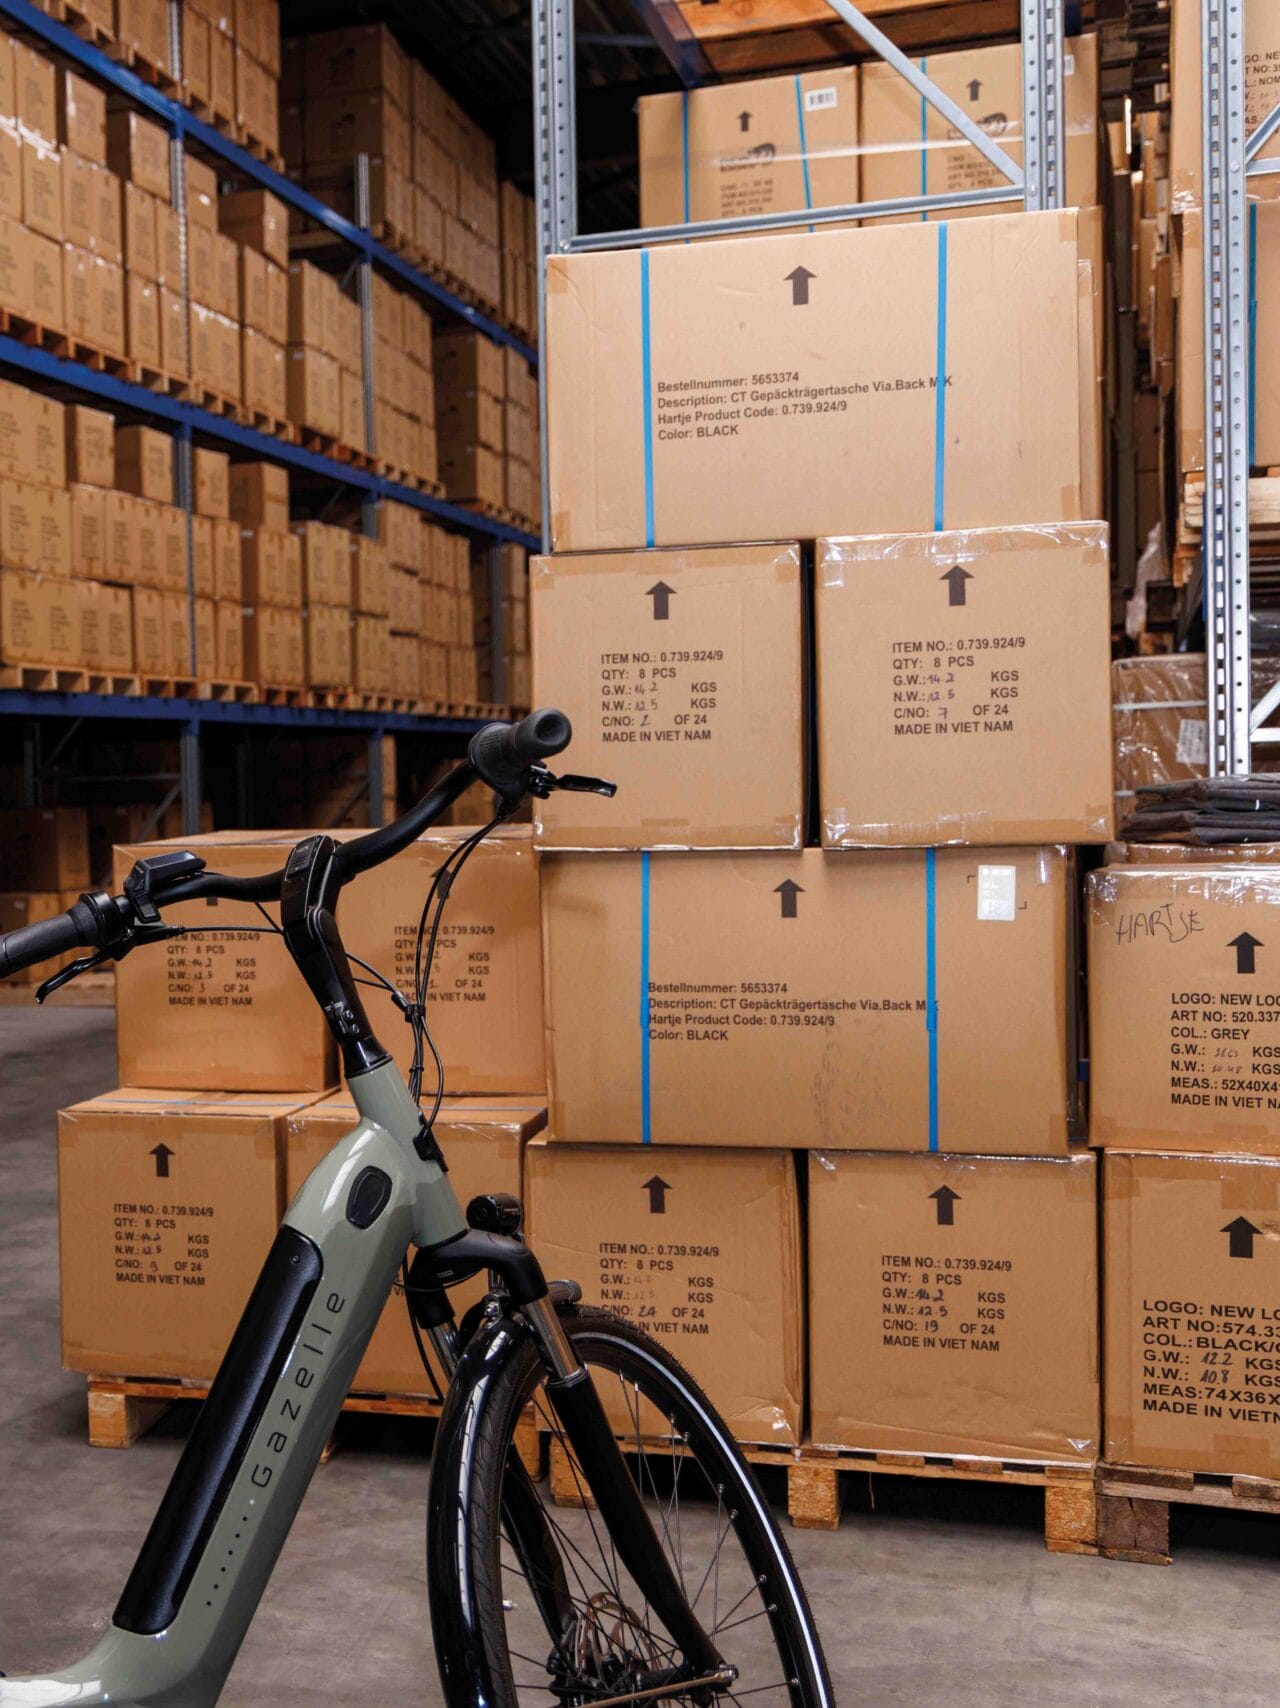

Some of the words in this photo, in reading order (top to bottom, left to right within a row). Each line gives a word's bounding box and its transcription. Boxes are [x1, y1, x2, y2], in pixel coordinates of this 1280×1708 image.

[658, 377, 747, 393] Bestellnummer:
[752, 372, 799, 386] 5653374
[658, 394, 726, 409] Description:
[731, 392, 747, 403] CT
[751, 383, 869, 403] Gepäckträgertasche
[873, 378, 925, 392] Via.Back
[658, 411, 692, 425] Hartje
[696, 407, 741, 422] Product
[744, 405, 778, 418] Code:
[782, 400, 847, 415] 0.739.924/9
[658, 428, 693, 440] Color:
[697, 425, 739, 438] BLACK
[893, 642, 922, 653] ITEM
[927, 640, 952, 651] NO.:
[956, 637, 1026, 650] 0.739.924/9
[601, 654, 629, 664] ITEM
[632, 653, 657, 663] NO.:
[660, 650, 723, 662] 0.739.924/9
[893, 658, 922, 670] QTY:
[934, 658, 940, 667] 8
[948, 656, 974, 666] PCS
[601, 669, 629, 680] QTY:
[639, 669, 645, 678] 8
[652, 668, 676, 678] PCS
[894, 675, 925, 686] G.W.:
[991, 671, 1019, 682] KGS
[601, 685, 631, 695] G.W.:
[691, 682, 717, 693] KGS
[894, 691, 925, 702] N.W.:
[991, 687, 1018, 698] KGS
[602, 701, 631, 711] N.W.:
[691, 698, 716, 708] KGS
[894, 708, 929, 718] C/NO:
[973, 705, 990, 715] OF
[994, 704, 1008, 715] 24
[602, 716, 634, 727] C/NO:
[674, 715, 690, 725] OF
[694, 714, 707, 724] 24
[894, 724, 931, 735] MADE
[936, 723, 947, 734] IN
[952, 722, 980, 733] VIET
[984, 721, 1013, 732] NAM
[602, 731, 636, 742] MADE
[640, 731, 651, 741] IN
[655, 730, 680, 741] VIET
[684, 730, 711, 740] NAM
[649, 982, 736, 994] Bestellnummer:
[741, 983, 787, 994] 5653374
[649, 998, 716, 1011] Description:
[720, 999, 736, 1010] CT
[740, 999, 857, 1013] Gepäckträgertasche
[860, 999, 912, 1011] Via.Back
[1172, 993, 1215, 1005] LOGO:
[1220, 994, 1252, 1006] NEW
[649, 1014, 682, 1027] Hartje
[685, 1014, 730, 1025] Product
[734, 1015, 767, 1026] Code:
[771, 1015, 835, 1027] 0.739.924/9
[1171, 1011, 1198, 1021] ART
[1203, 1011, 1227, 1022] NO:
[649, 1029, 683, 1041] Color:
[687, 1030, 728, 1041] BLACK
[1171, 1027, 1207, 1039] COL.:
[1211, 1028, 1250, 1040] GREY
[1171, 1044, 1205, 1055] G.W.:
[1171, 1060, 1205, 1072] N.W.:
[1171, 1077, 1217, 1089] MEAS.:
[1171, 1094, 1210, 1106] MADE
[1215, 1096, 1228, 1106] IN
[1232, 1097, 1262, 1109] VIET
[114, 1203, 136, 1213] ITEM
[162, 1206, 214, 1216] 0.739.924/9
[115, 1218, 137, 1227] QTY:
[156, 1219, 176, 1229] PCS
[882, 1256, 911, 1266] ITEM
[915, 1257, 940, 1268] NO.:
[945, 1258, 1012, 1272] 0.739.924/9
[116, 1272, 144, 1283] MADE
[147, 1275, 156, 1283] IN
[159, 1275, 180, 1284] VIET
[183, 1276, 205, 1285] NAM
[882, 1272, 911, 1283] QTY:
[922, 1274, 928, 1284] 8
[936, 1274, 962, 1285] PCS
[882, 1288, 914, 1299] G.W.:
[978, 1292, 1006, 1303] KGS
[883, 1304, 914, 1315] N.W.:
[978, 1308, 1005, 1319] KGS
[1143, 1300, 1203, 1314] LOGO:
[1211, 1305, 1254, 1318] NEW
[883, 1319, 918, 1331] C/NO:
[960, 1323, 976, 1334] OF
[981, 1324, 995, 1335] 24
[1143, 1316, 1180, 1330] ART
[883, 1335, 919, 1347] MADE
[924, 1337, 935, 1348] IN
[939, 1338, 967, 1349] VIET
[971, 1340, 999, 1351] NAM
[1144, 1350, 1189, 1364] G.W.:
[1144, 1366, 1188, 1381] N.W.:
[251, 1293, 345, 1488] Gazelle
[1144, 1399, 1198, 1414] MADE
[1204, 1405, 1221, 1417] IN
